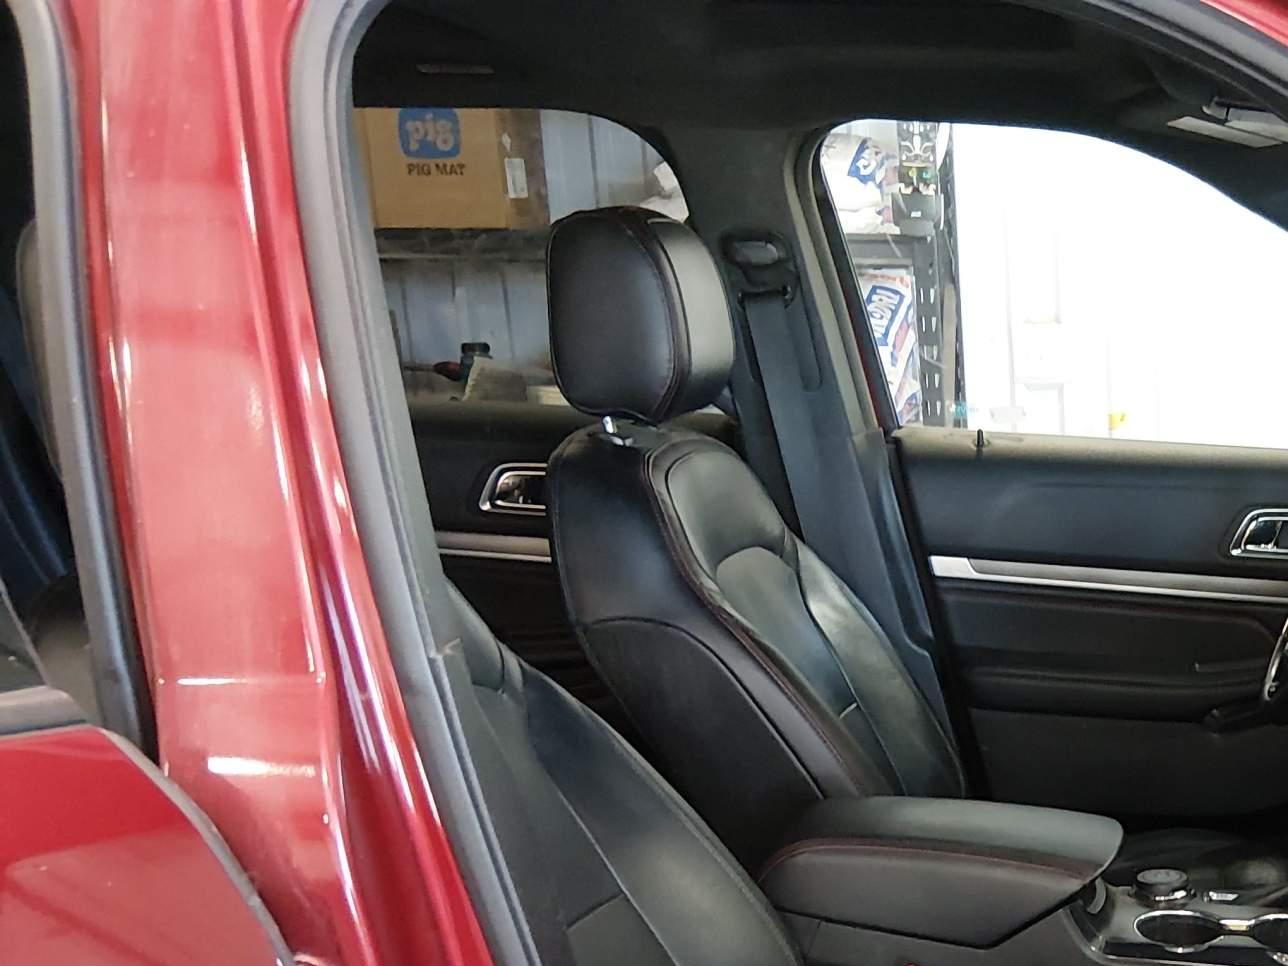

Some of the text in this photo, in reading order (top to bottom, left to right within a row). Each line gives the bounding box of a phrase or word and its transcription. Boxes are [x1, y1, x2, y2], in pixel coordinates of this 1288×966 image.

[405, 112, 455, 152] pig
[406, 162, 466, 176] PIG MAT
